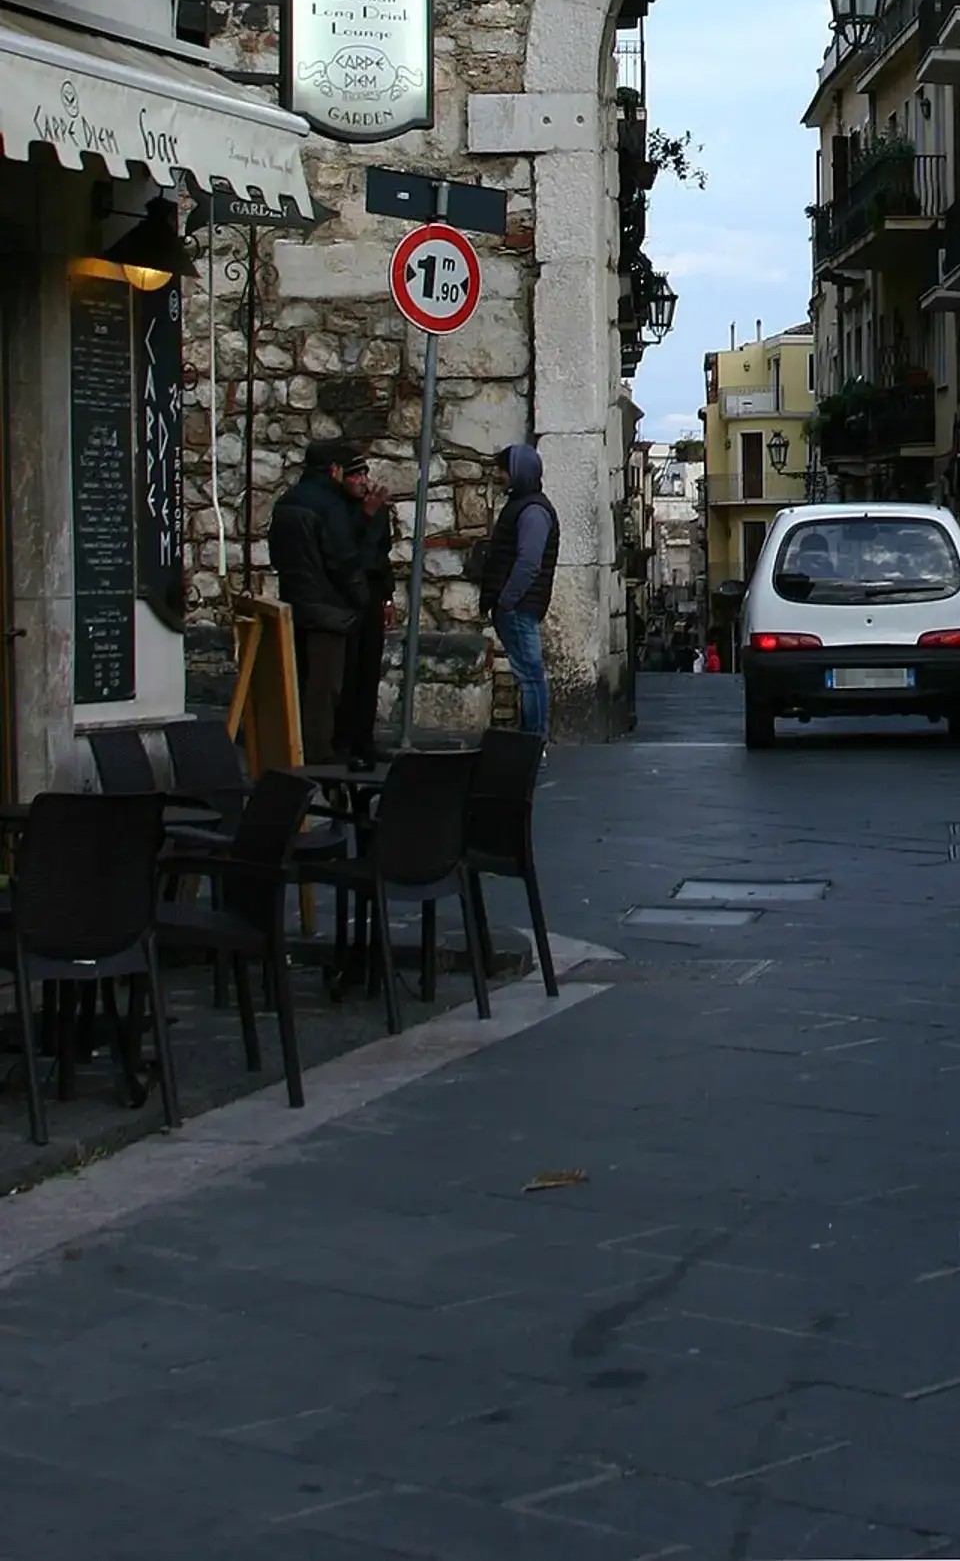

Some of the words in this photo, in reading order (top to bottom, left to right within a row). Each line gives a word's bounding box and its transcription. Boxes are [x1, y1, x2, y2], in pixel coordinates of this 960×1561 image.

[312, 3, 354, 20] Long
[332, 22, 392, 40] Lounge
[336, 55, 385, 71] CARPE
[345, 73, 376, 88] DIEM
[328, 106, 394, 126] GARDEN
[82, 116, 121, 155] DIEM
[138, 108, 179, 165] bar
[230, 202, 288, 218] GARD
[442, 257, 456, 272] m
[144, 318, 157, 517] CARPE
[158, 411, 171, 567] DIEM
[173, 446, 181, 559] TRATTORIA
